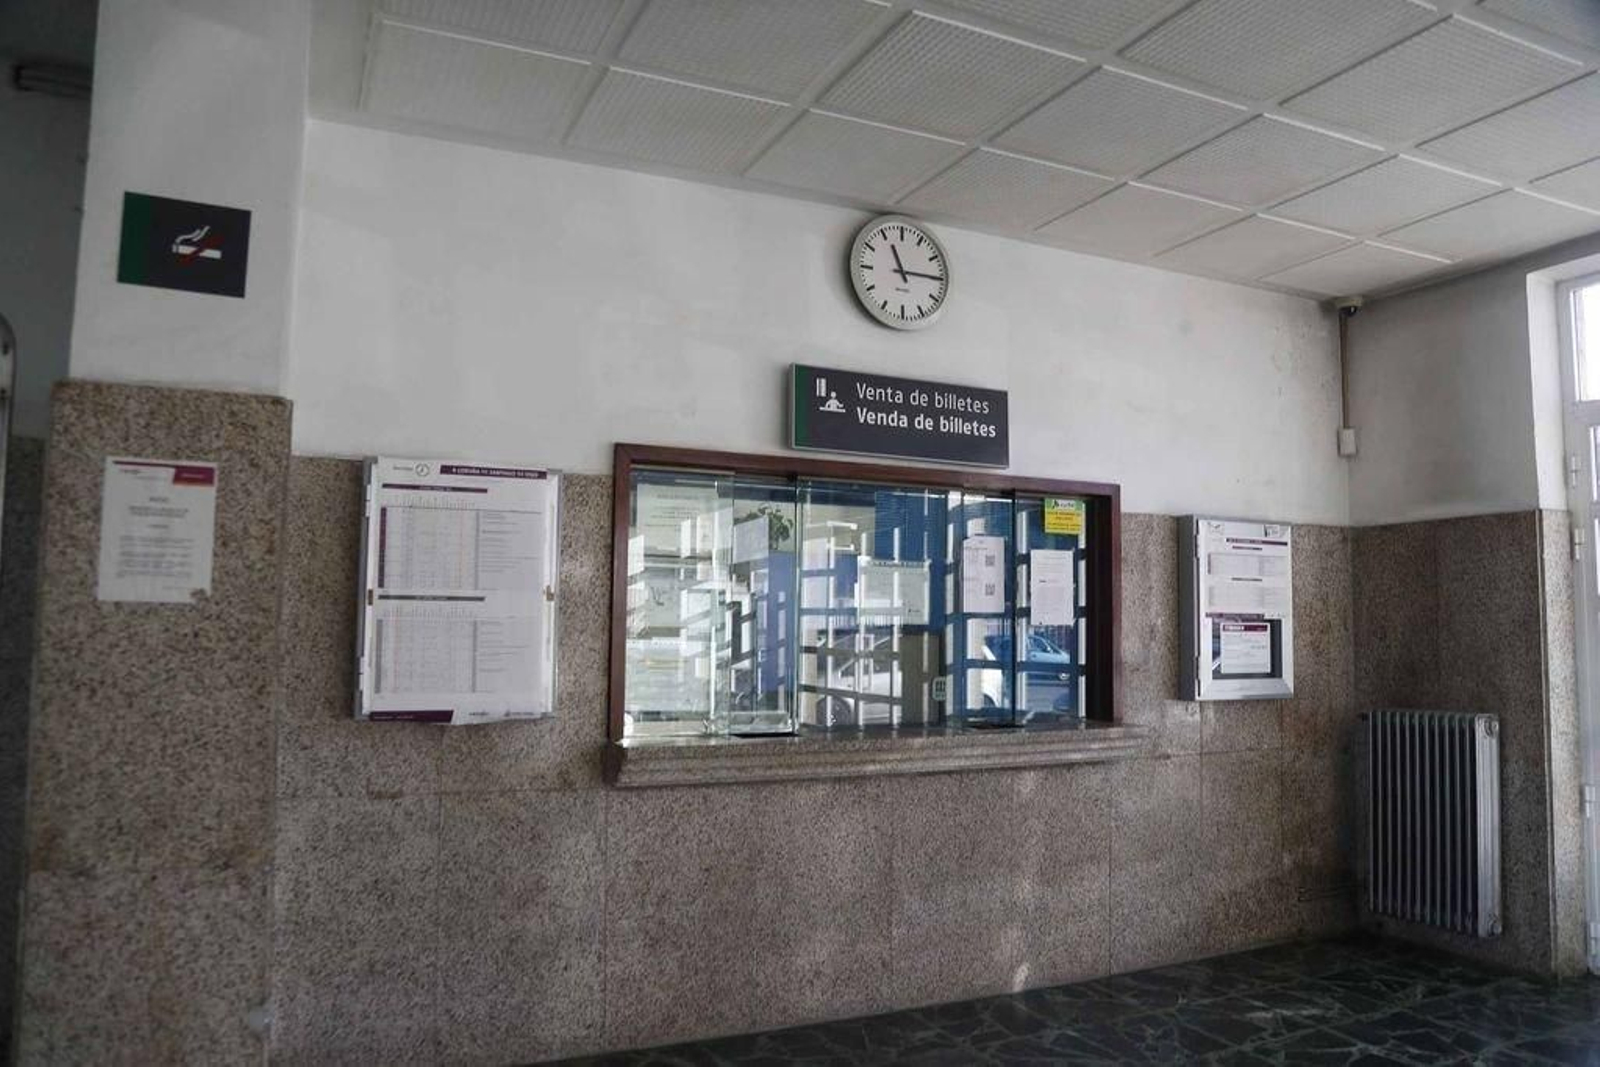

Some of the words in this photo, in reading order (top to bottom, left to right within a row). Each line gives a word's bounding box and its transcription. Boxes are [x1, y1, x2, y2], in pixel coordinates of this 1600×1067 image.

[856, 382, 904, 404] Venta
[910, 390, 929, 407] de
[935, 391, 990, 414] billetes
[856, 407, 908, 428] Venda
[915, 413, 934, 431] de
[939, 416, 997, 438] billetes
